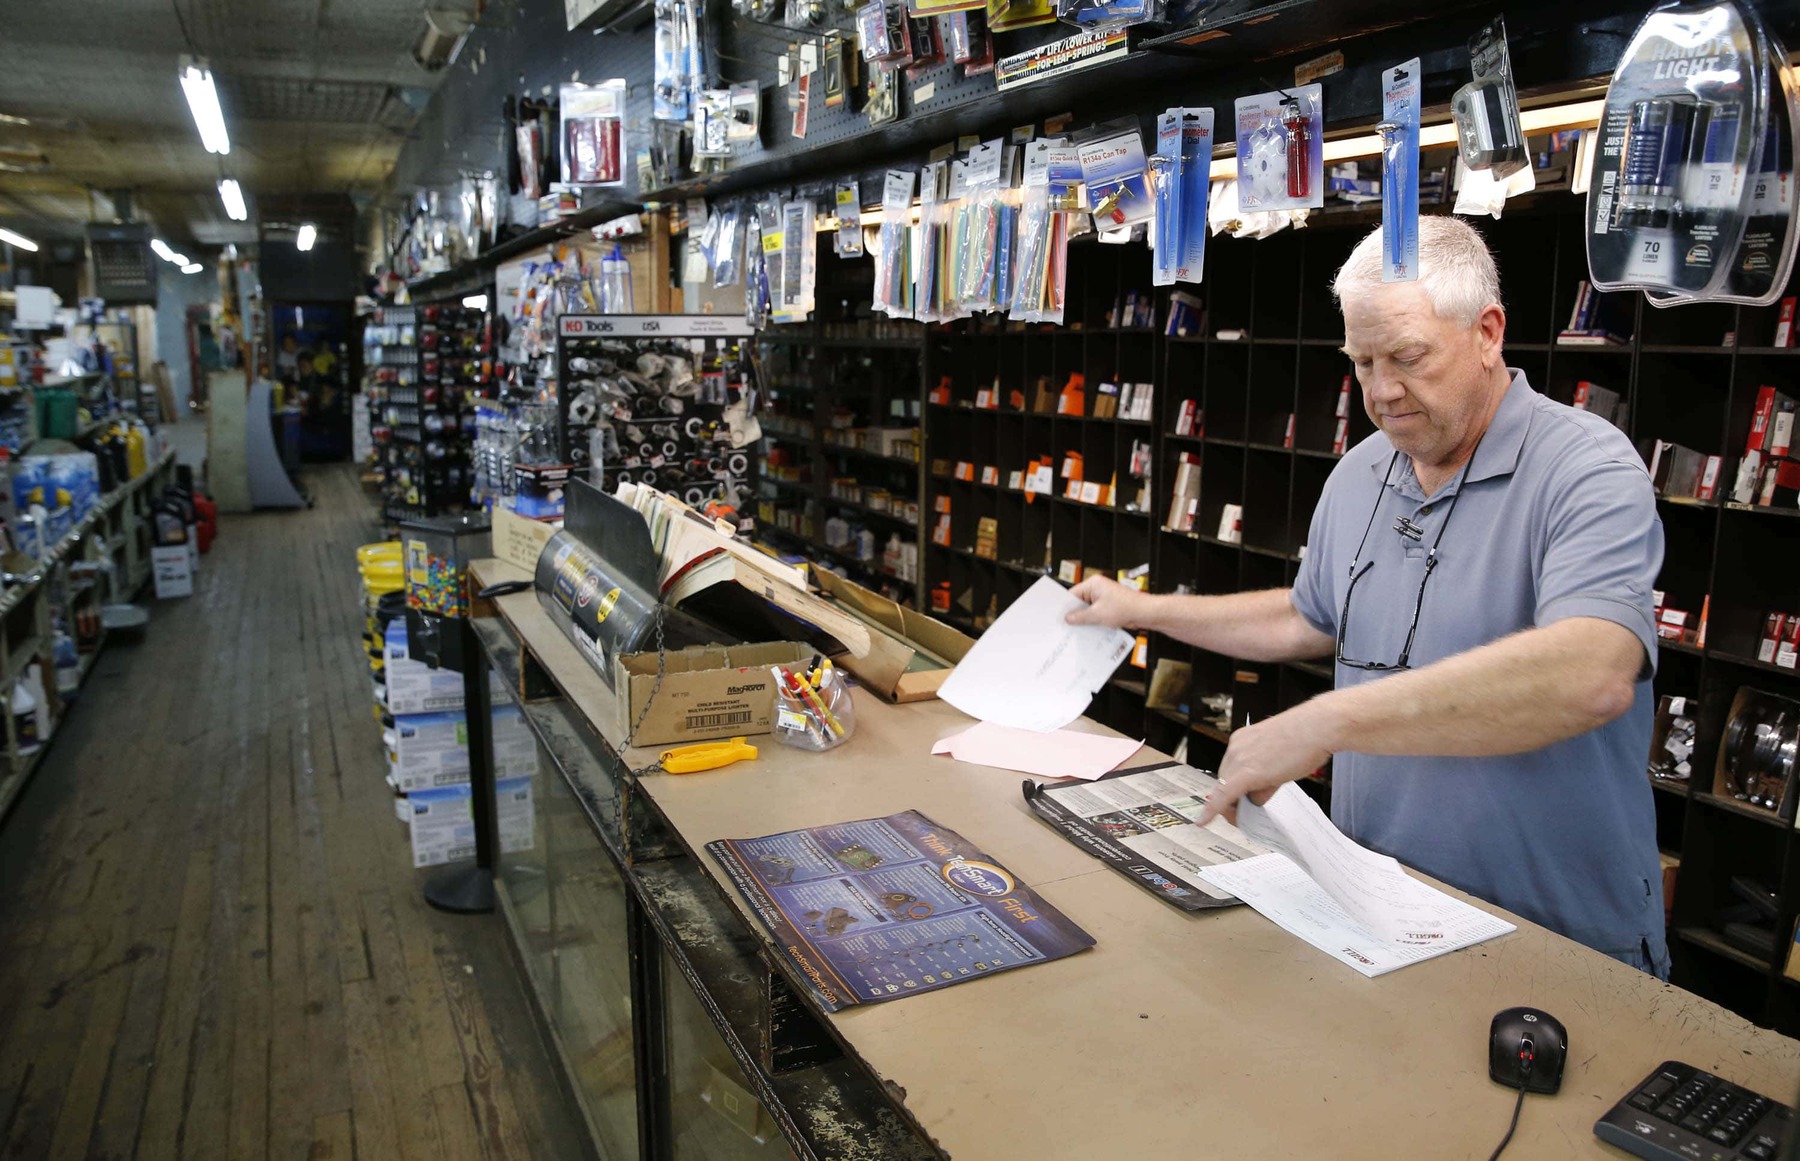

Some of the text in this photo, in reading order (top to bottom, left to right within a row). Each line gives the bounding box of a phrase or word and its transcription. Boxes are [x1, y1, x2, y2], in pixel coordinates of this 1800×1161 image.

[1654, 57, 1719, 80] LIGHT
[1605, 136, 1624, 146] JUST
[1083, 147, 1127, 164] R134a Can Tap
[1604, 146, 1618, 156] THE
[1755, 184, 1766, 192] 70
[1644, 242, 1660, 252] 70
[586, 321, 614, 332] Tools
[642, 322, 660, 331] USA
[1076, 826, 1095, 837] motor
[1080, 835, 1094, 844] why
[1091, 836, 1131, 860] conventional
[1092, 844, 1118, 858] reasons
[920, 834, 1038, 924] Think TechSmart First
[1141, 872, 1191, 896] Mobil
[740, 886, 763, 908] professional
[1341, 948, 1375, 965] ORGILL
[787, 945, 838, 1005] TechSmartParts.com
